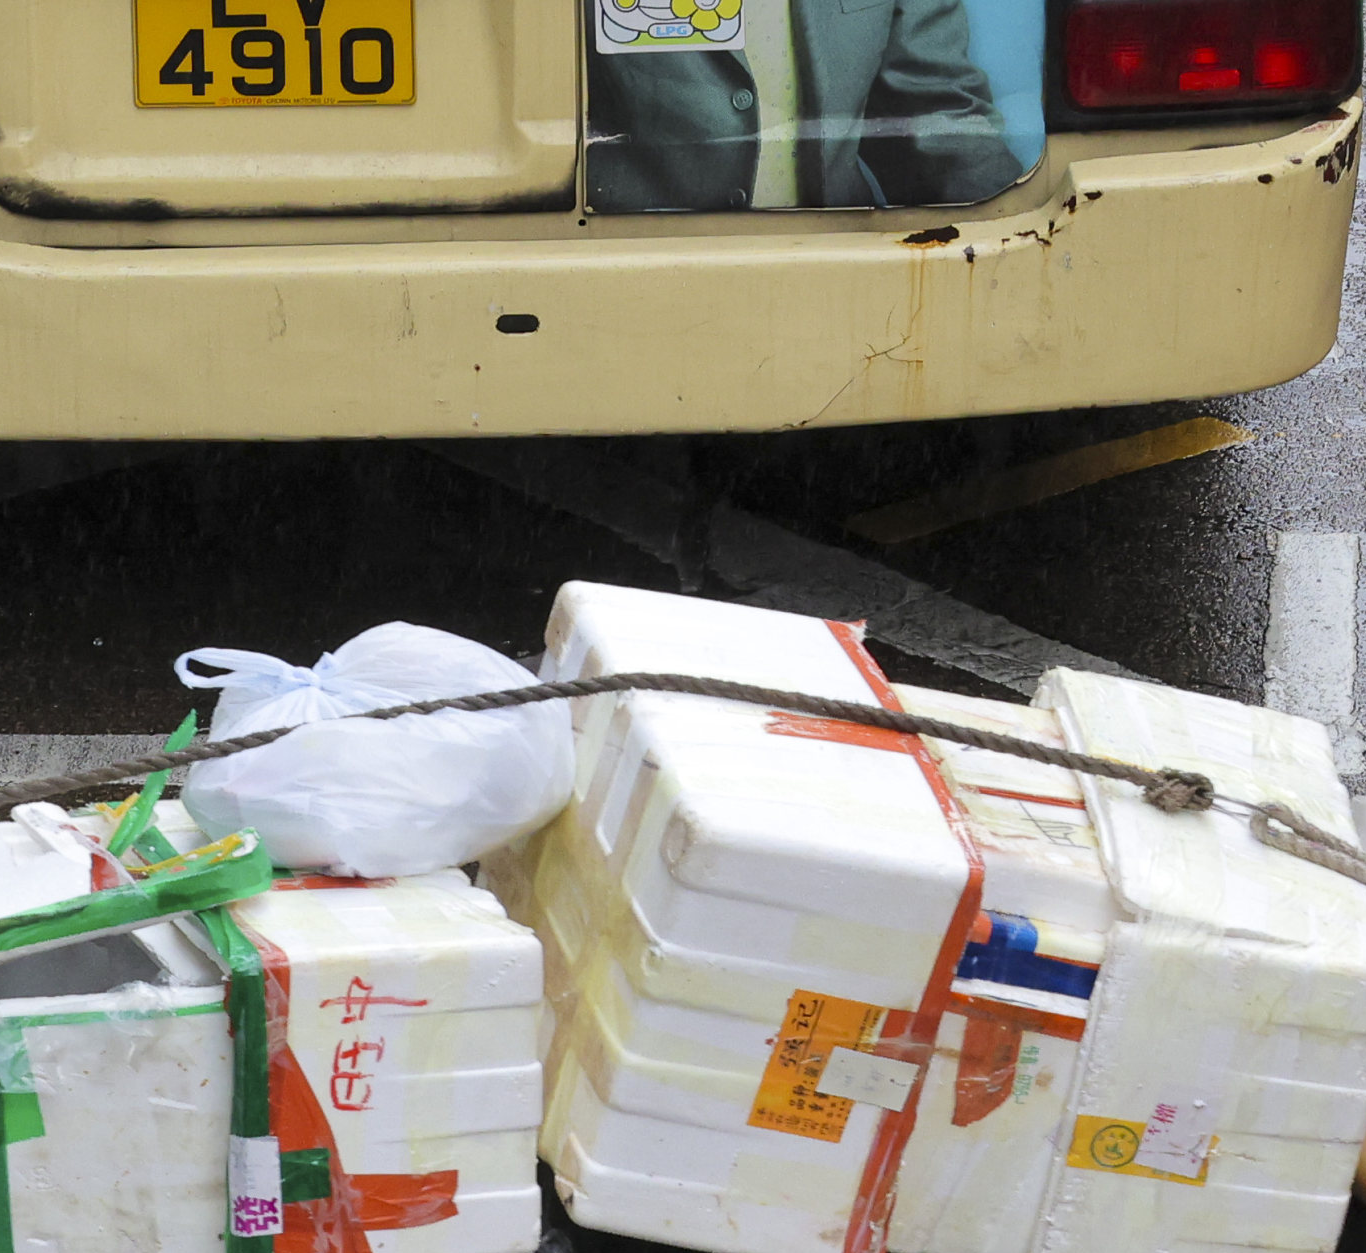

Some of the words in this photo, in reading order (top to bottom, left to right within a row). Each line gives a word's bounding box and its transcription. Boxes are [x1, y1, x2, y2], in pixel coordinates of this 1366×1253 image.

[656, 26, 688, 37] LPG
[160, 28, 394, 97] 4910
[231, 97, 262, 105] TOYOTA
